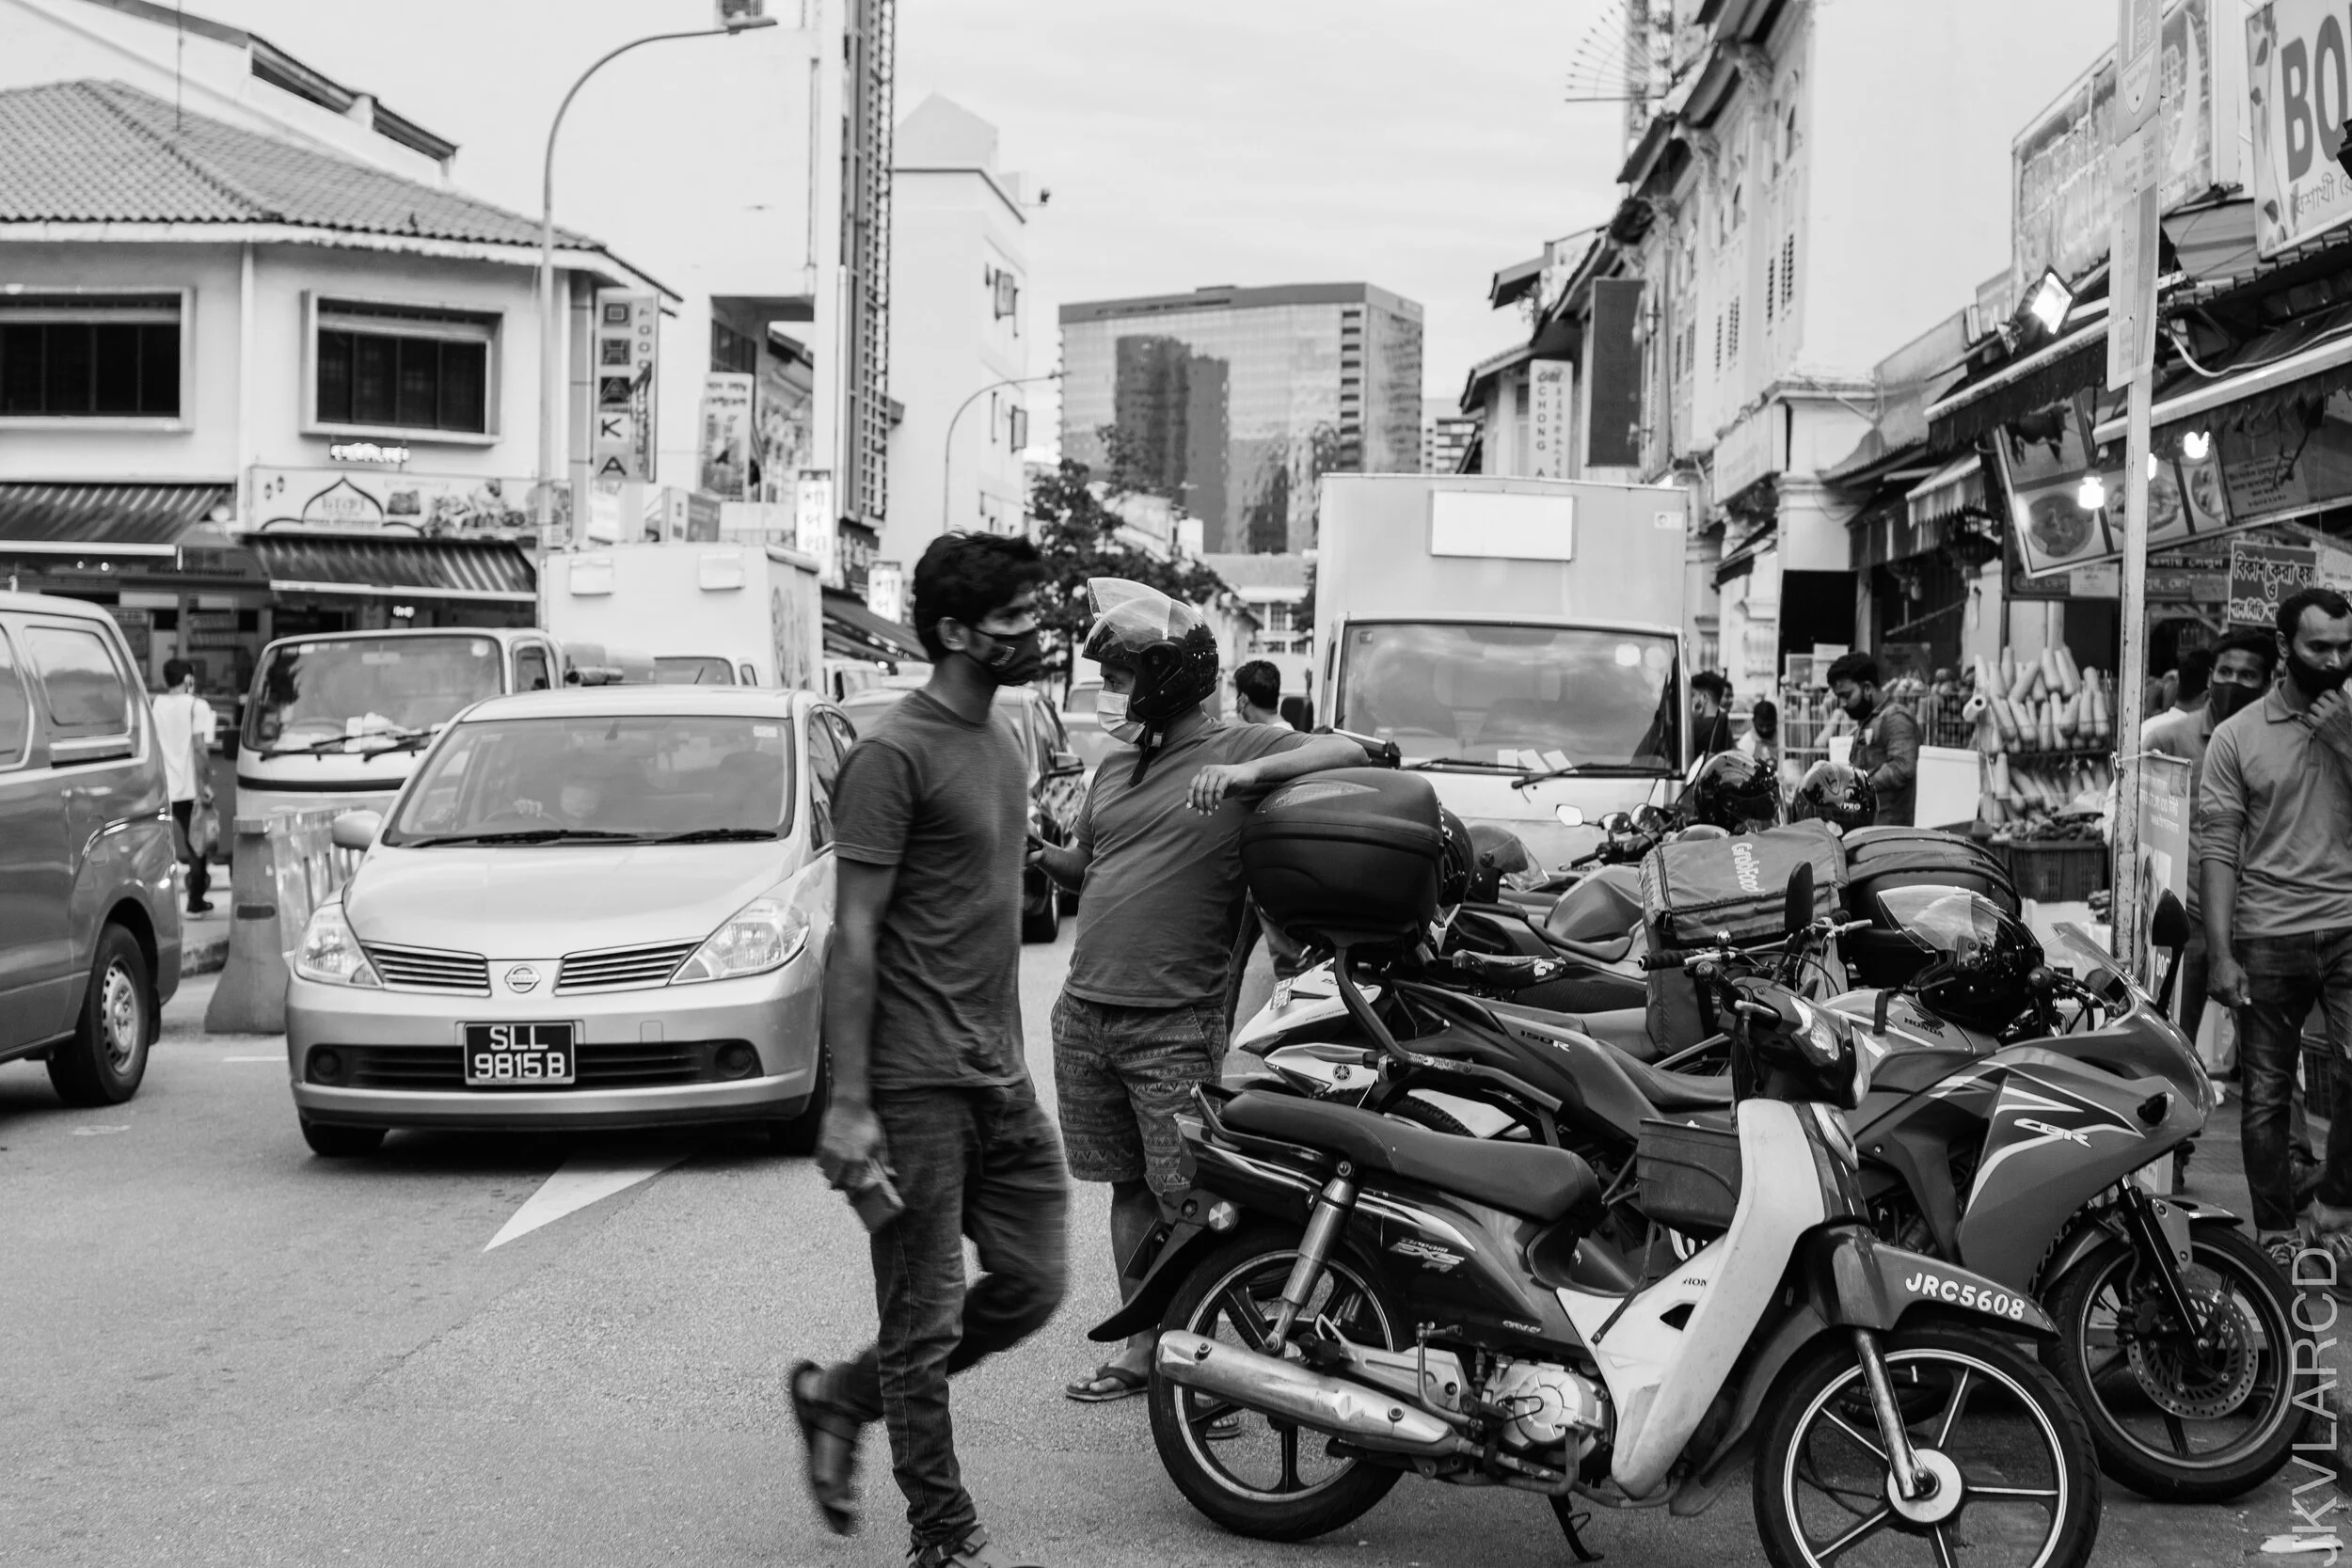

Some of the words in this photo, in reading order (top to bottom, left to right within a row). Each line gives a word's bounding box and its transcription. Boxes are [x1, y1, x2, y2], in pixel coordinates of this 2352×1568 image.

[2280, 9, 2352, 182] BO
[600, 302, 630, 476] DHAKA
[1731, 842, 1766, 893] GrabFood
[489, 1024, 549, 1051] SLL
[1903, 1016, 1945, 1039] HONDA
[1682, 1277, 1707, 1288] HON
[1905, 1272, 2026, 1321] JRC5608
